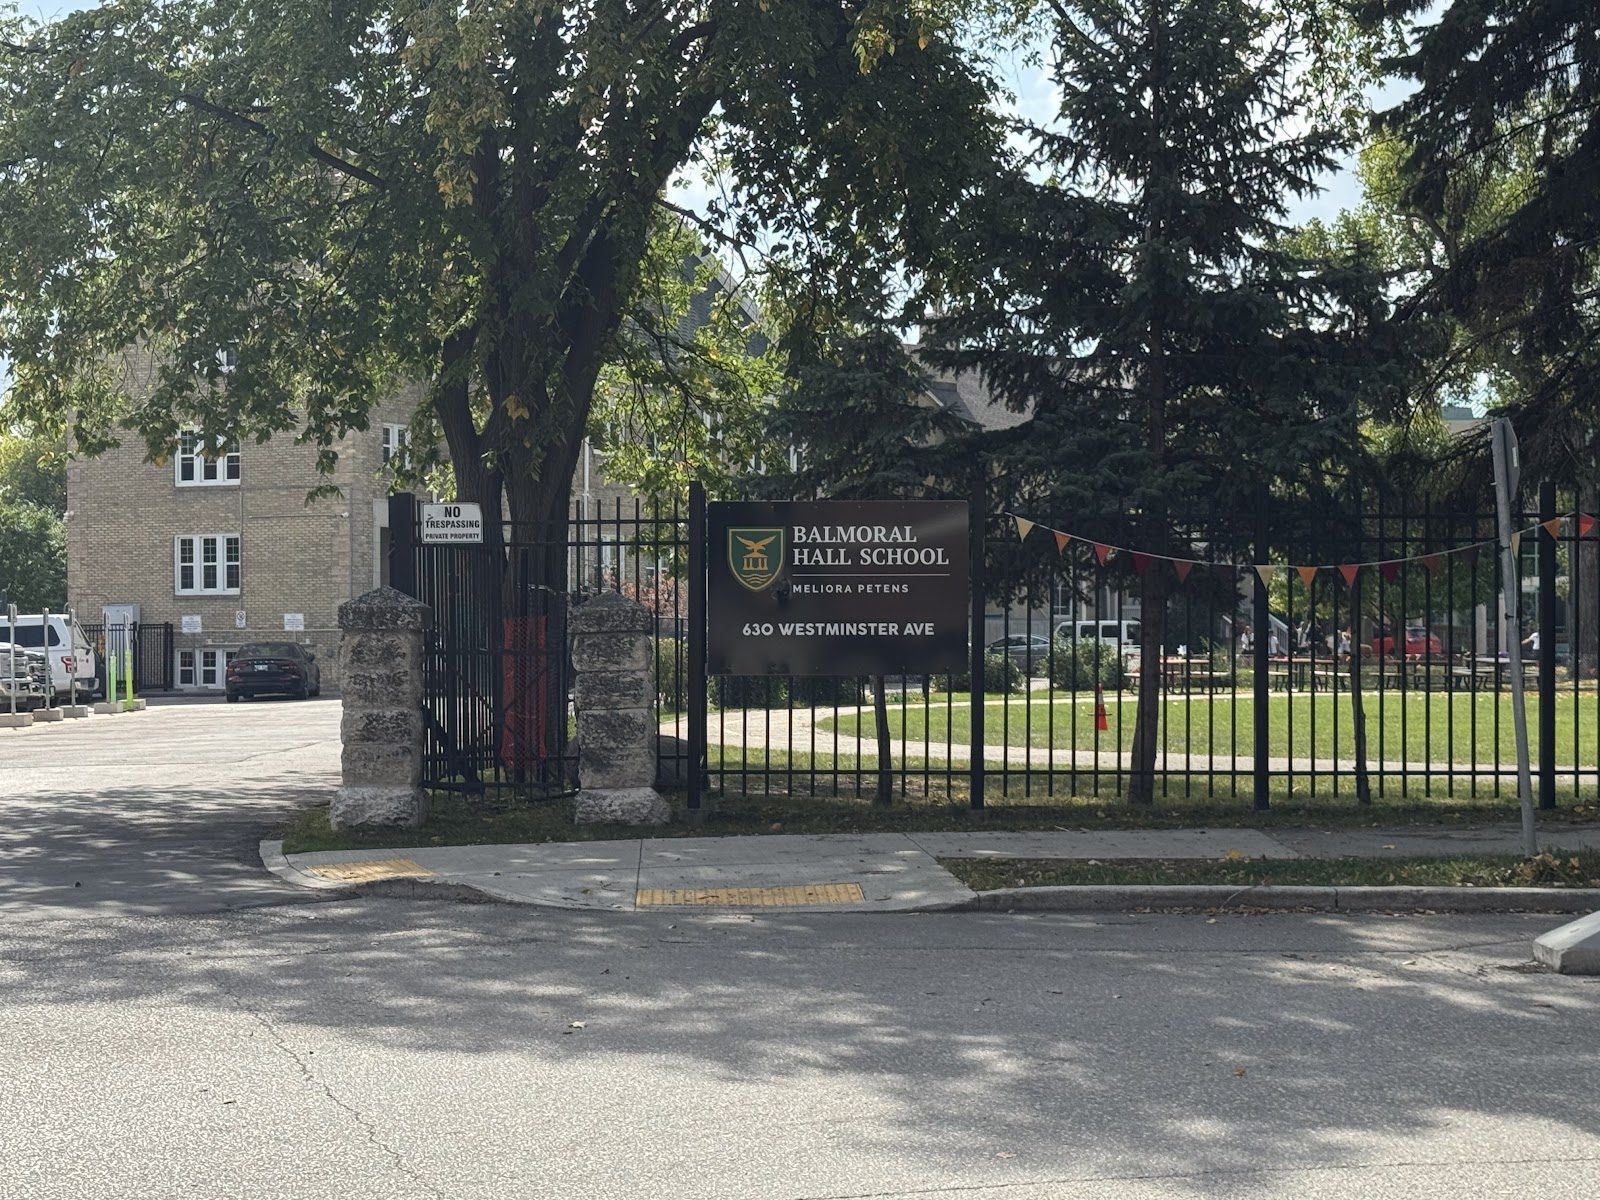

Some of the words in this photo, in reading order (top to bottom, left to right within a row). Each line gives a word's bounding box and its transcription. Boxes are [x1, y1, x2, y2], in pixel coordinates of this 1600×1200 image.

[444, 506, 461, 518] NO
[425, 520, 480, 529] TRESPASSING
[792, 526, 917, 543] BALMORAL
[792, 548, 852, 566] HALL
[859, 547, 950, 566] SCHOOL
[792, 584, 852, 593] MELIORA
[858, 584, 909, 593] PETENS
[742, 622, 774, 636] 630
[778, 622, 899, 636] WESTMINSTER
[903, 622, 935, 636] AVE
